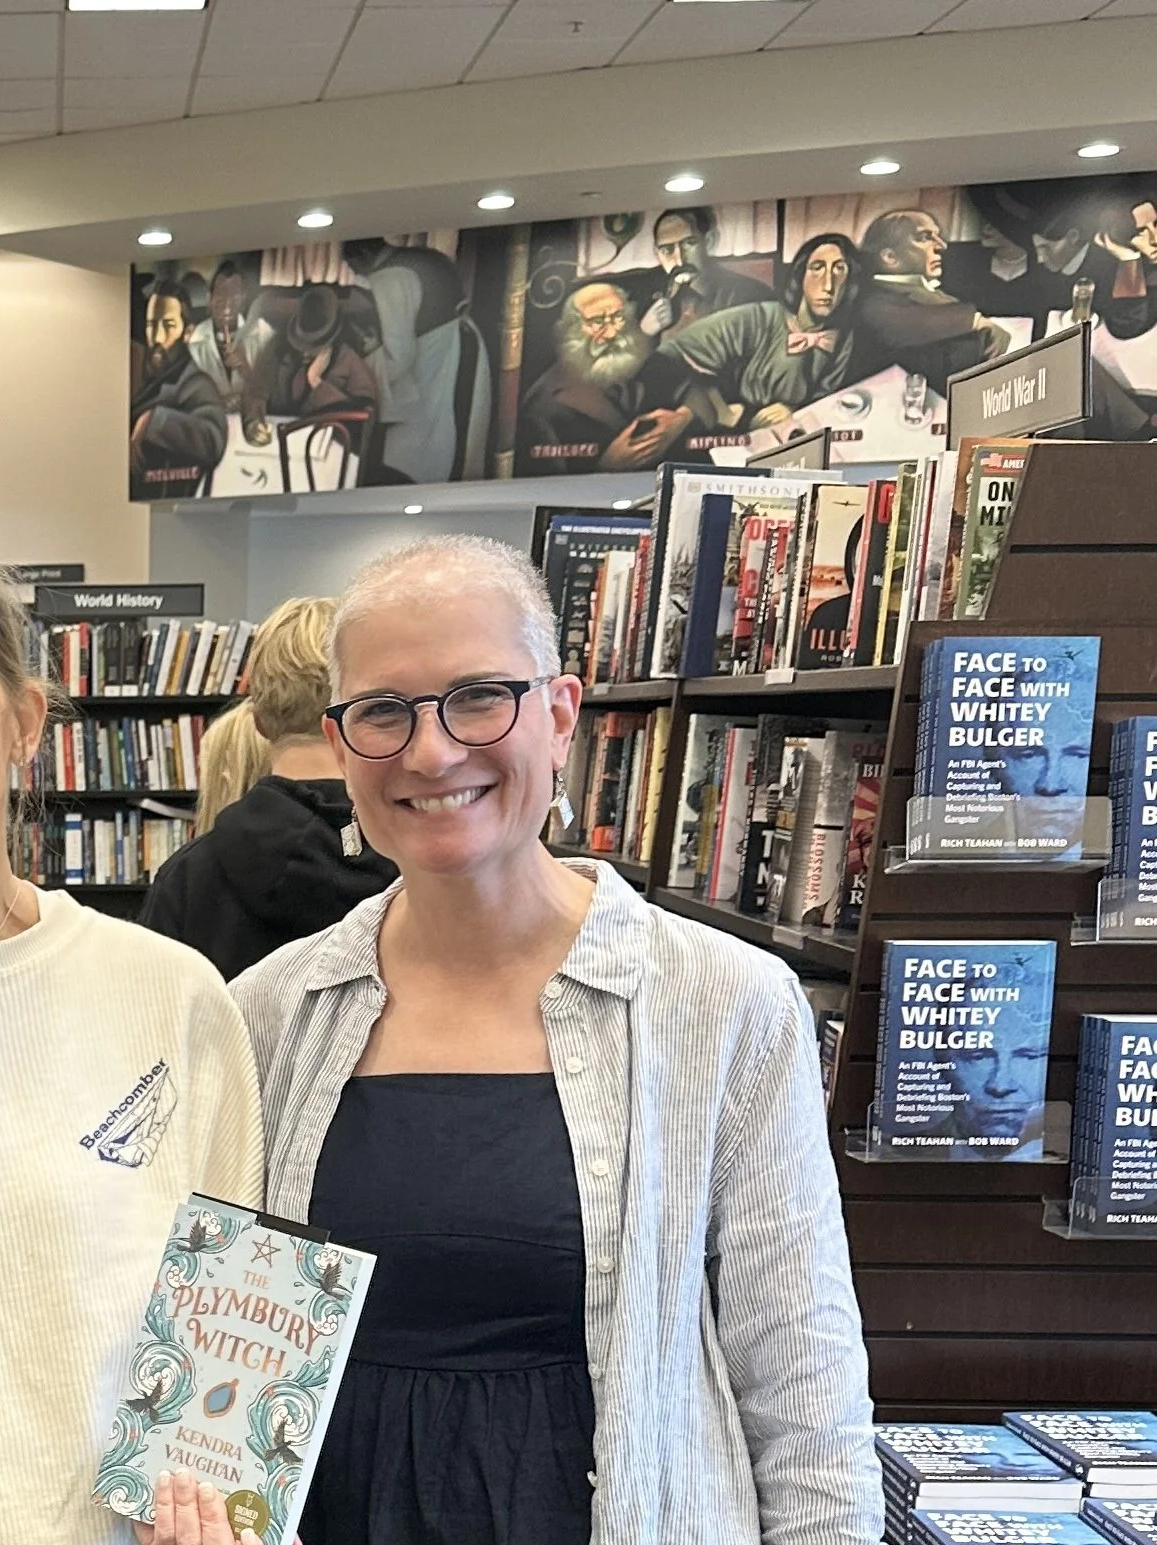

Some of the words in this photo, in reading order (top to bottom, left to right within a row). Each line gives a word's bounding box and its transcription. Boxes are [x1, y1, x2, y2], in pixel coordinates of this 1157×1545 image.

[983, 380, 1012, 419] World
[1014, 375, 1035, 408] War
[1038, 367, 1046, 400] II
[706, 483, 801, 496] SMITHSONI
[74, 594, 113, 608] World
[116, 594, 164, 610] History
[953, 652, 1017, 673] FACE
[1022, 657, 1047, 672] TO
[952, 677, 1015, 698] FACE
[1020, 682, 1070, 697] WITH
[950, 702, 1052, 722] WHITEY
[948, 727, 1044, 747] BULGER
[947, 760, 959, 769] An
[960, 760, 975, 769] FBI
[946, 771, 979, 780] Account
[980, 771, 990, 780] of
[945, 782, 985, 792] Capturing
[986, 782, 1001, 791] and
[945, 804, 965, 813] Most
[966, 804, 1004, 813] Notorious
[944, 815, 980, 825] Gangster
[940, 839, 963, 848] RICH
[964, 839, 1003, 848] TEAHAN
[1017, 839, 1037, 848] BOB
[1038, 839, 1068, 848] WARD
[903, 958, 967, 978] FACE
[971, 963, 997, 978] TO
[902, 983, 965, 1002] FACE
[970, 988, 1020, 1002] WITH
[901, 1006, 1002, 1026] WHITEY
[899, 1030, 994, 1049] BULGER
[898, 1061, 911, 1070] An
[898, 1072, 931, 1081] Account
[931, 1072, 941, 1081] of
[897, 1083, 936, 1093] Capturing
[936, 1083, 952, 1091] and
[79, 1057, 166, 1150] Beachcomber
[896, 1103, 916, 1112] Most
[917, 1103, 955, 1112] Notorious
[895, 1114, 931, 1124] Gangster
[892, 1137, 915, 1146] RICH
[916, 1137, 954, 1146] TEAHAN
[968, 1137, 988, 1146] BOB
[989, 1137, 1019, 1146] WARD
[1113, 1149, 1146, 1158] Account
[1112, 1160, 1151, 1170] Capturing
[1111, 1181, 1131, 1190] Most
[1110, 1191, 1146, 1202] Gangster
[1106, 1214, 1129, 1223] RICH
[1130, 1214, 1157, 1224] TEAHA
[242, 1269, 273, 1290] THE
[172, 1285, 321, 1356] PLYMBURY
[186, 1317, 287, 1377] WITCH
[175, 1425, 242, 1461] KENDRA
[165, 1444, 244, 1484] VAUGHAN
